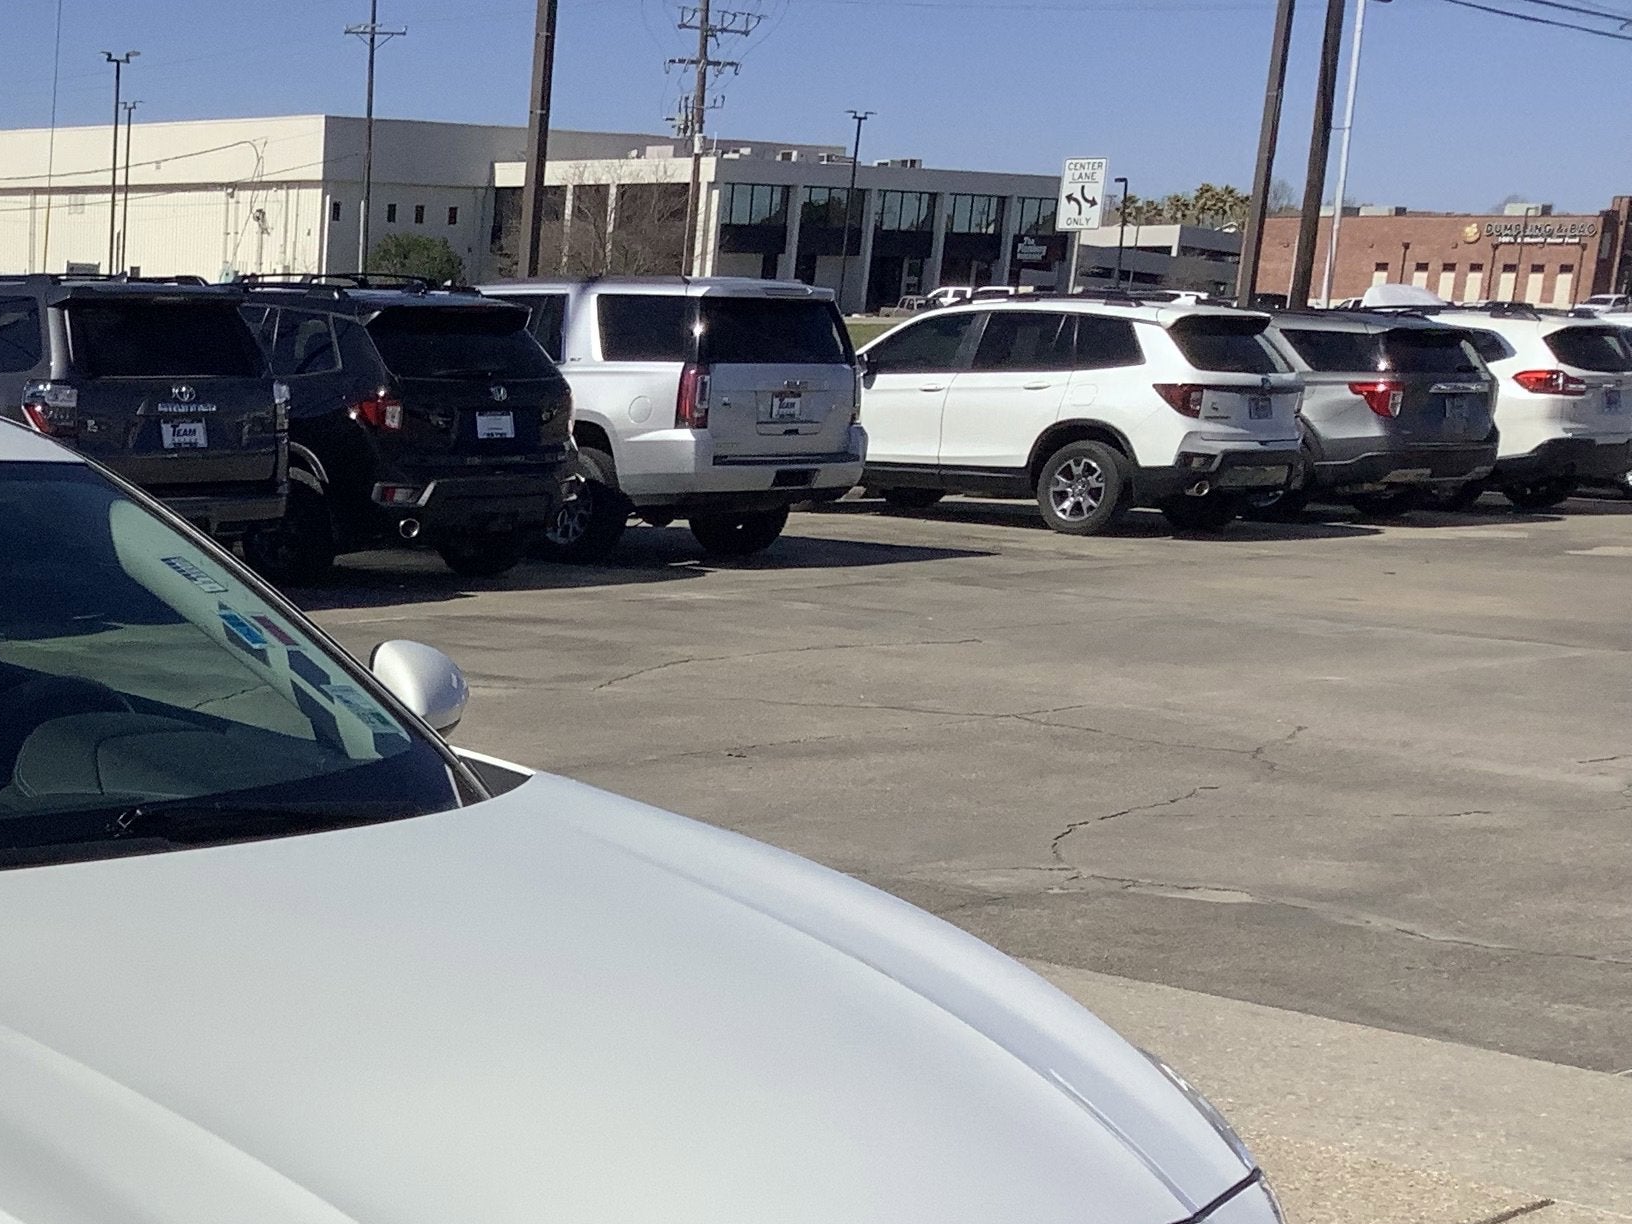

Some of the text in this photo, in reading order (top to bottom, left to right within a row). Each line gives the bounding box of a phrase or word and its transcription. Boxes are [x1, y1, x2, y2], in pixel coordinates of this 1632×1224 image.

[1067, 161, 1104, 171] CENTER
[1071, 172, 1098, 181] LANE
[1065, 217, 1091, 226] ONLY
[1569, 223, 1597, 238] BAO
